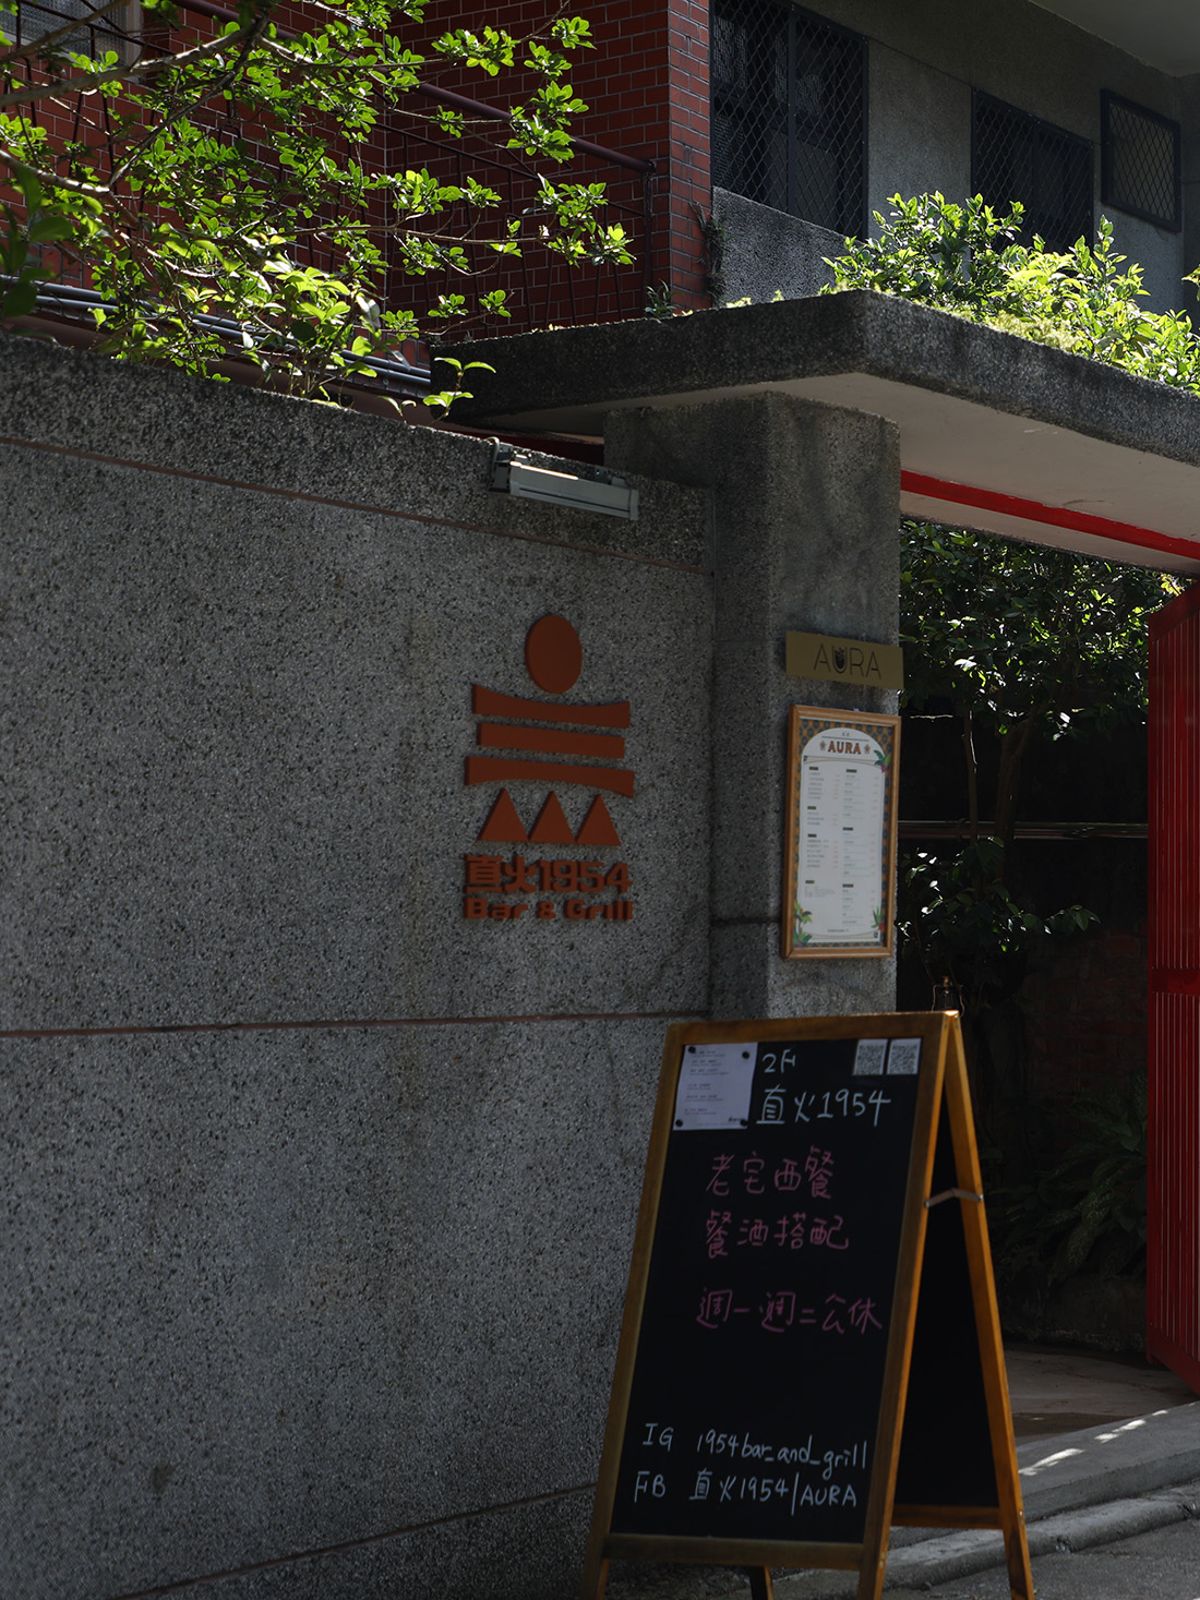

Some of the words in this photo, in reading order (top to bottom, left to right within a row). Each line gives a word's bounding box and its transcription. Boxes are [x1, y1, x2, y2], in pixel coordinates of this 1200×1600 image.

[813, 643, 882, 680] AURA
[828, 740, 862, 754] AURA
[463, 854, 633, 894] 直火1954
[463, 898, 529, 920] Bar
[535, 899, 556, 920] &
[563, 899, 634, 921] Grill
[762, 1050, 796, 1073] 2F
[756, 1083, 892, 1127] 直火1954
[706, 1146, 834, 1199] 老宅西餐
[706, 1210, 849, 1259] 餐酒搭配
[696, 1287, 882, 1334] 週一週二公休
[642, 1422, 675, 1452] IG
[697, 1428, 868, 1481] 1954bar_and_grill
[635, 1470, 666, 1503] FB
